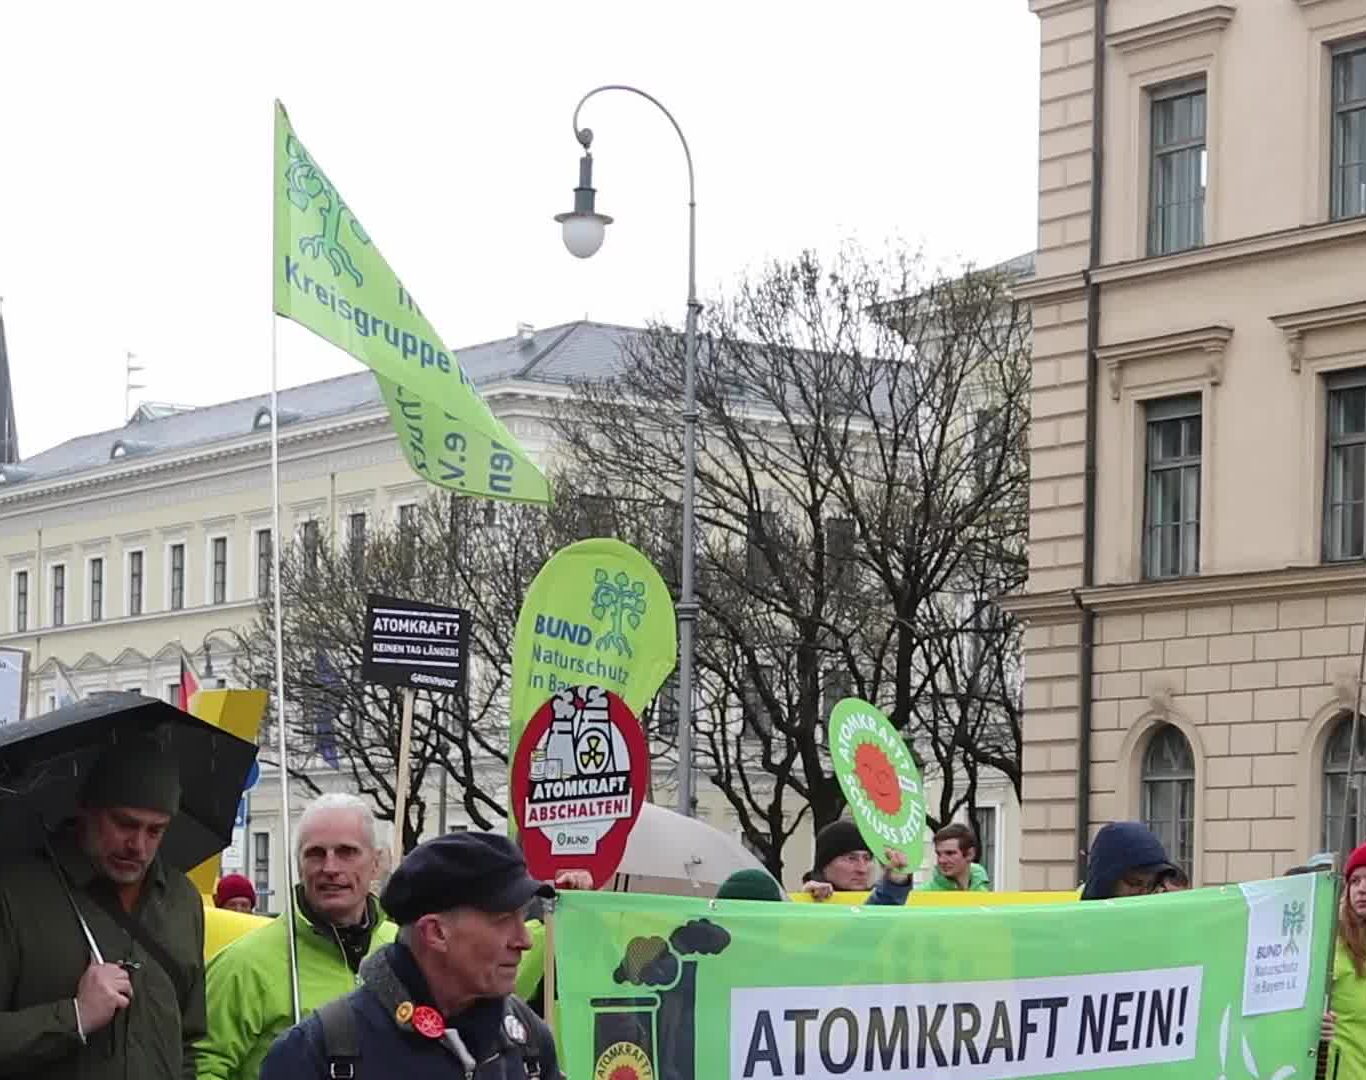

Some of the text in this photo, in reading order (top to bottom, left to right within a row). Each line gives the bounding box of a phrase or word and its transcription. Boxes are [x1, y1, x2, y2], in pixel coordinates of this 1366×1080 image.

[285, 255, 451, 373] Kreisgruppe
[373, 617, 459, 635] ATOMKRAFT?
[534, 614, 592, 646] BUND
[373, 643, 459, 657] KEINEN TAG LÄNGER!
[531, 643, 629, 685] Naturschutz
[529, 673, 544, 689] in
[532, 776, 628, 800] ATOMKRAFT
[528, 799, 628, 822] ABSCHALTEN!
[1257, 944, 1283, 959] BUND
[743, 986, 1189, 1077] ATOMKRAFT NEIN!
